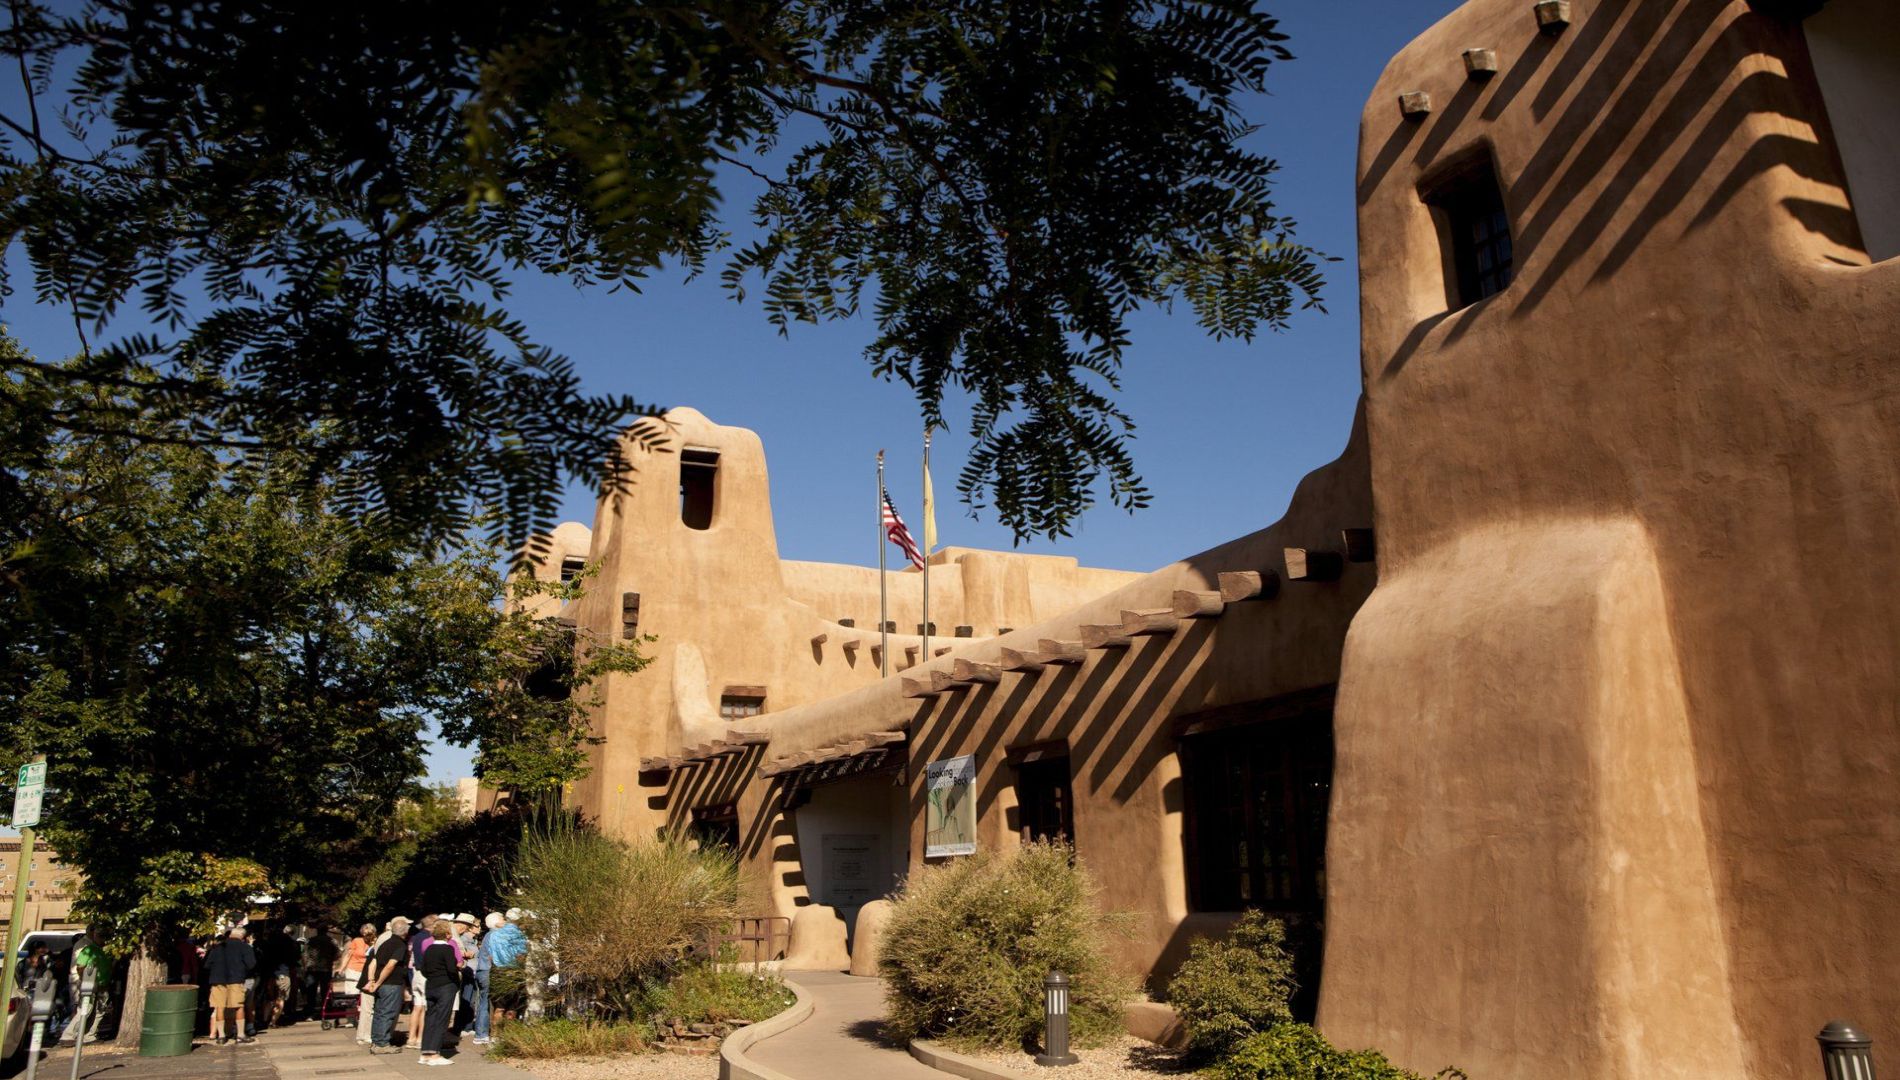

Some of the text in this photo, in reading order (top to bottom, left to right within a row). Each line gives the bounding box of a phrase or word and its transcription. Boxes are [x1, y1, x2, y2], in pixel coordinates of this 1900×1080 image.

[20, 769, 27, 785] 2
[929, 767, 953, 779] Looking
[954, 775, 968, 786] Back
